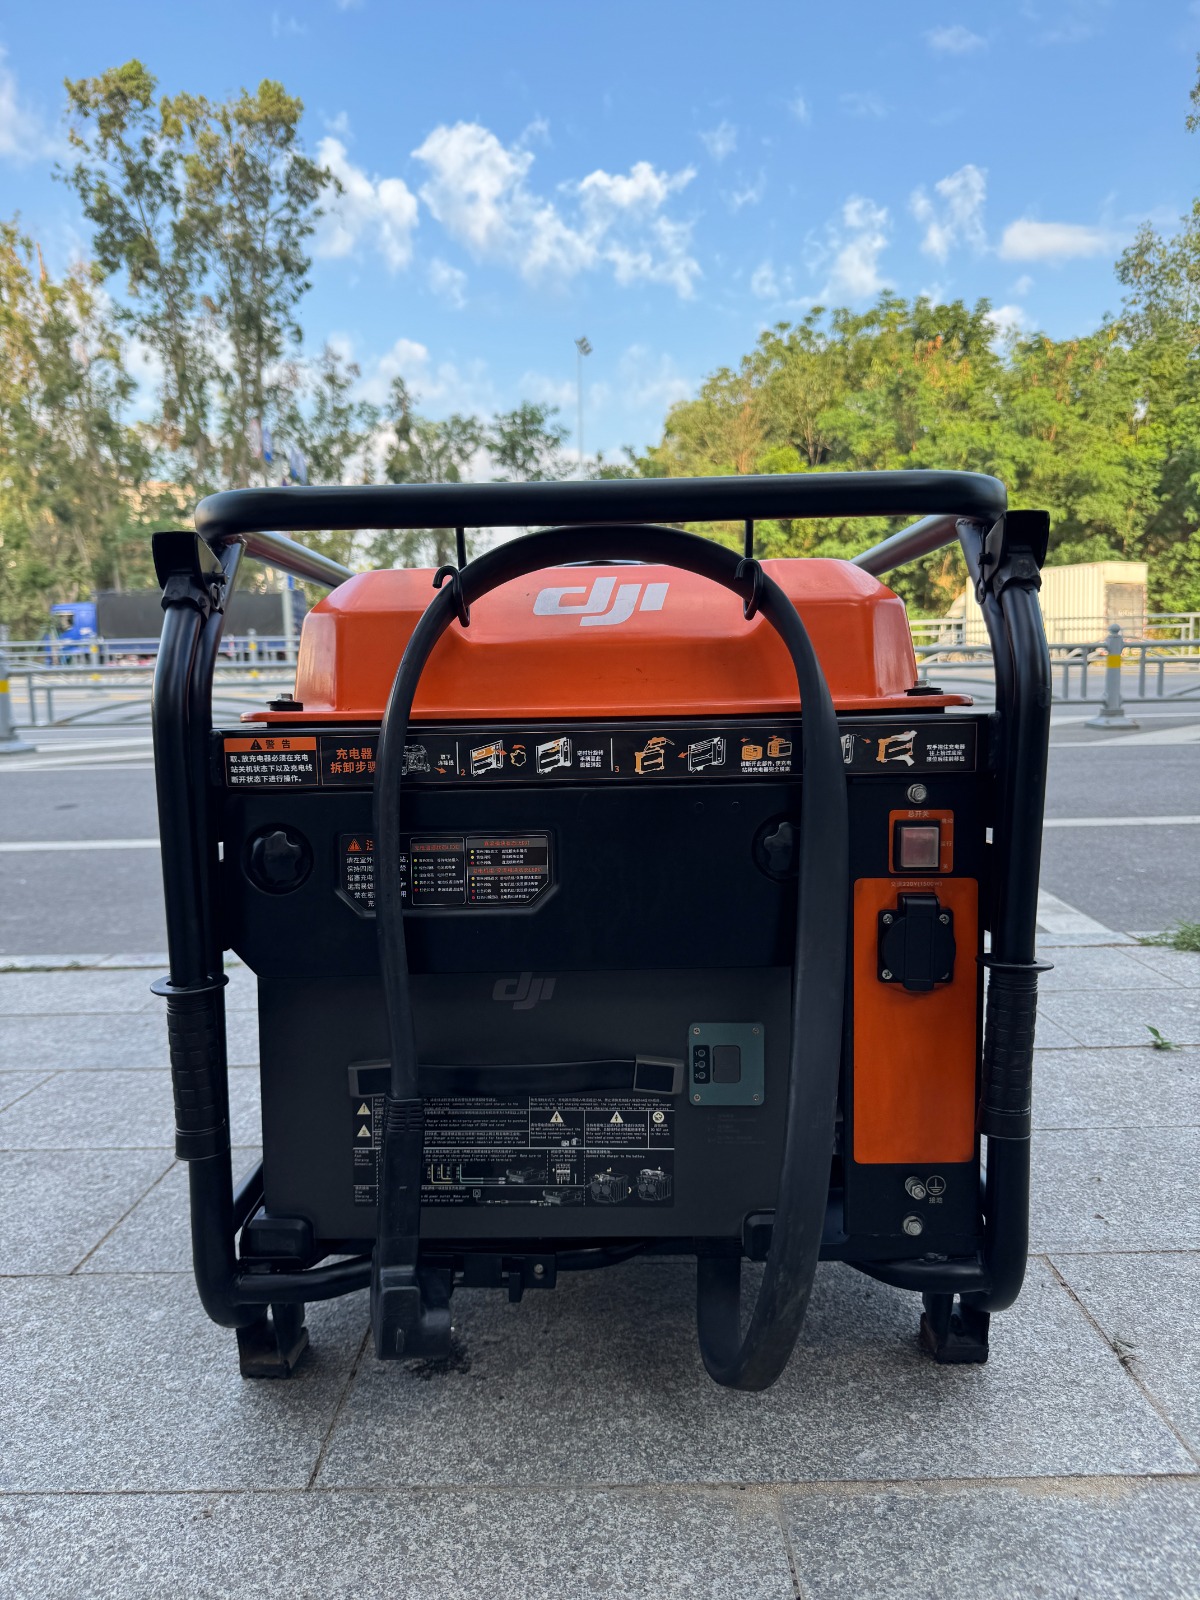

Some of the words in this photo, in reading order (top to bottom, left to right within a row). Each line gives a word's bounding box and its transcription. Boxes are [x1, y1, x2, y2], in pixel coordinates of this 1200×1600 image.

[336, 748, 374, 761] 充电器
[460, 768, 466, 776] 2
[614, 765, 620, 773] 3
[907, 810, 930, 819] 总开关
